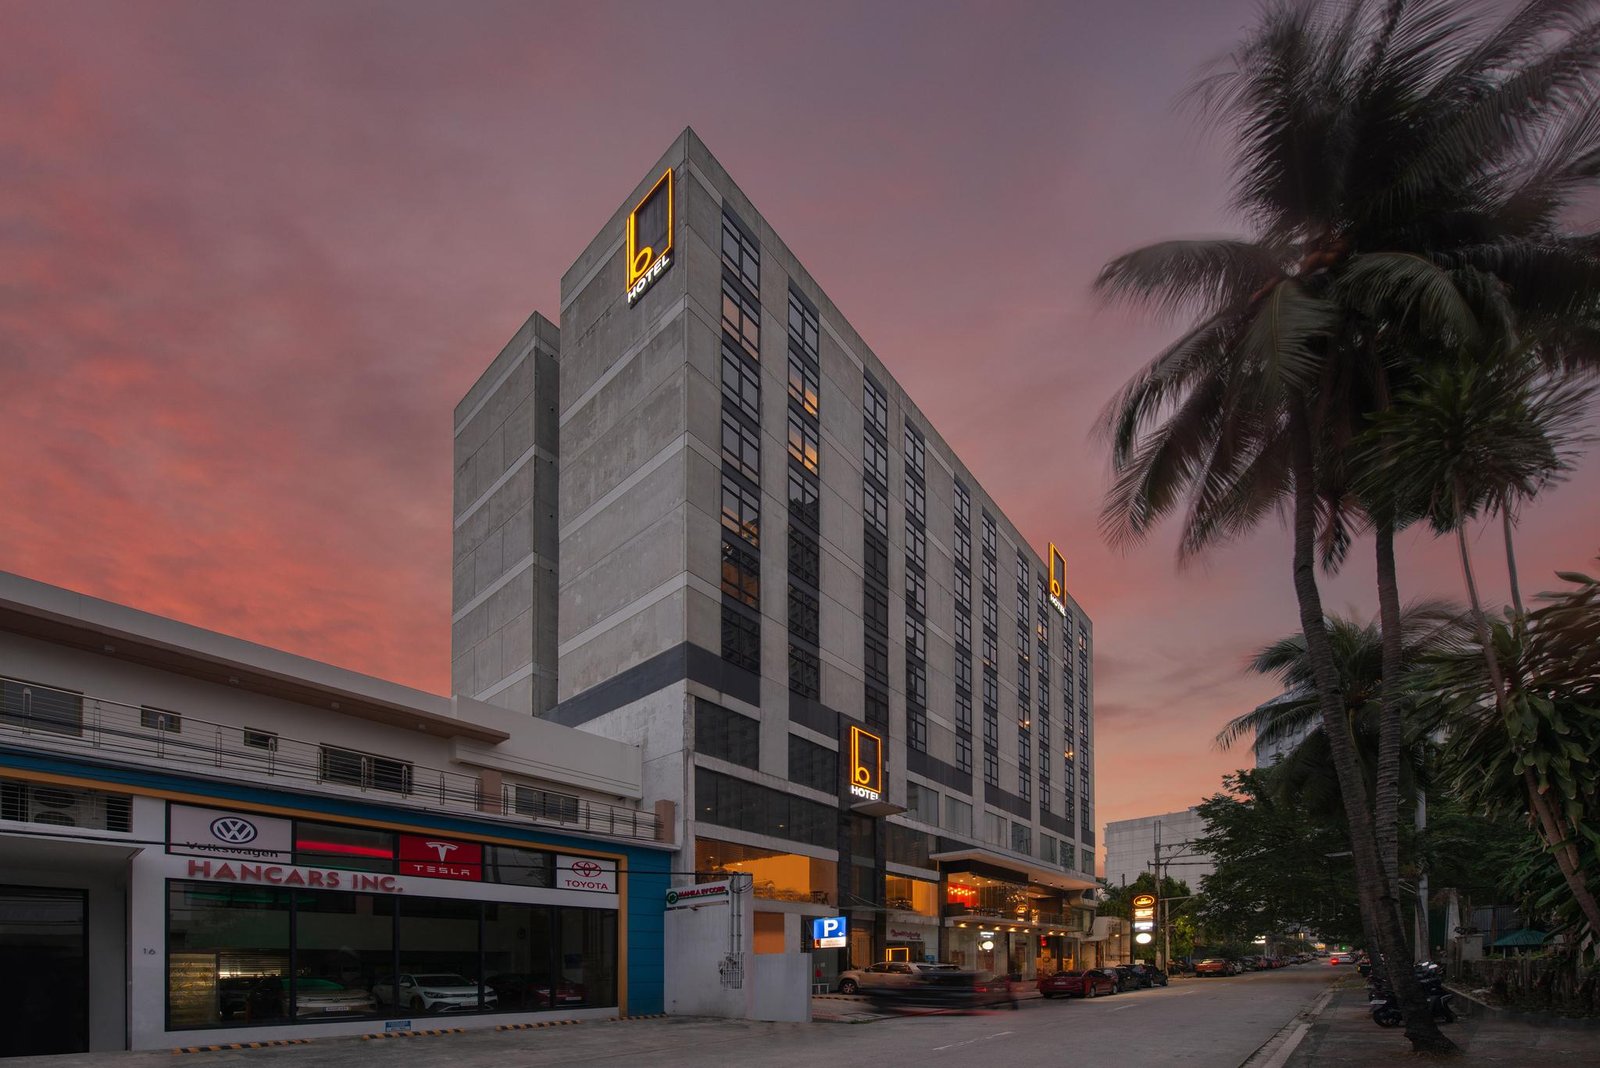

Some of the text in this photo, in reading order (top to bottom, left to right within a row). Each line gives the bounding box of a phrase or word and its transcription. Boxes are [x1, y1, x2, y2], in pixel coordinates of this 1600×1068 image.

[627, 254, 670, 303] HOTEL
[186, 842, 279, 858] Volkswagen
[188, 859, 403, 893] HANCARS INC.
[413, 864, 471, 876] TESLA
[565, 879, 608, 890] TOYOTA
[823, 919, 839, 937] P
[143, 947, 156, 956] 16
